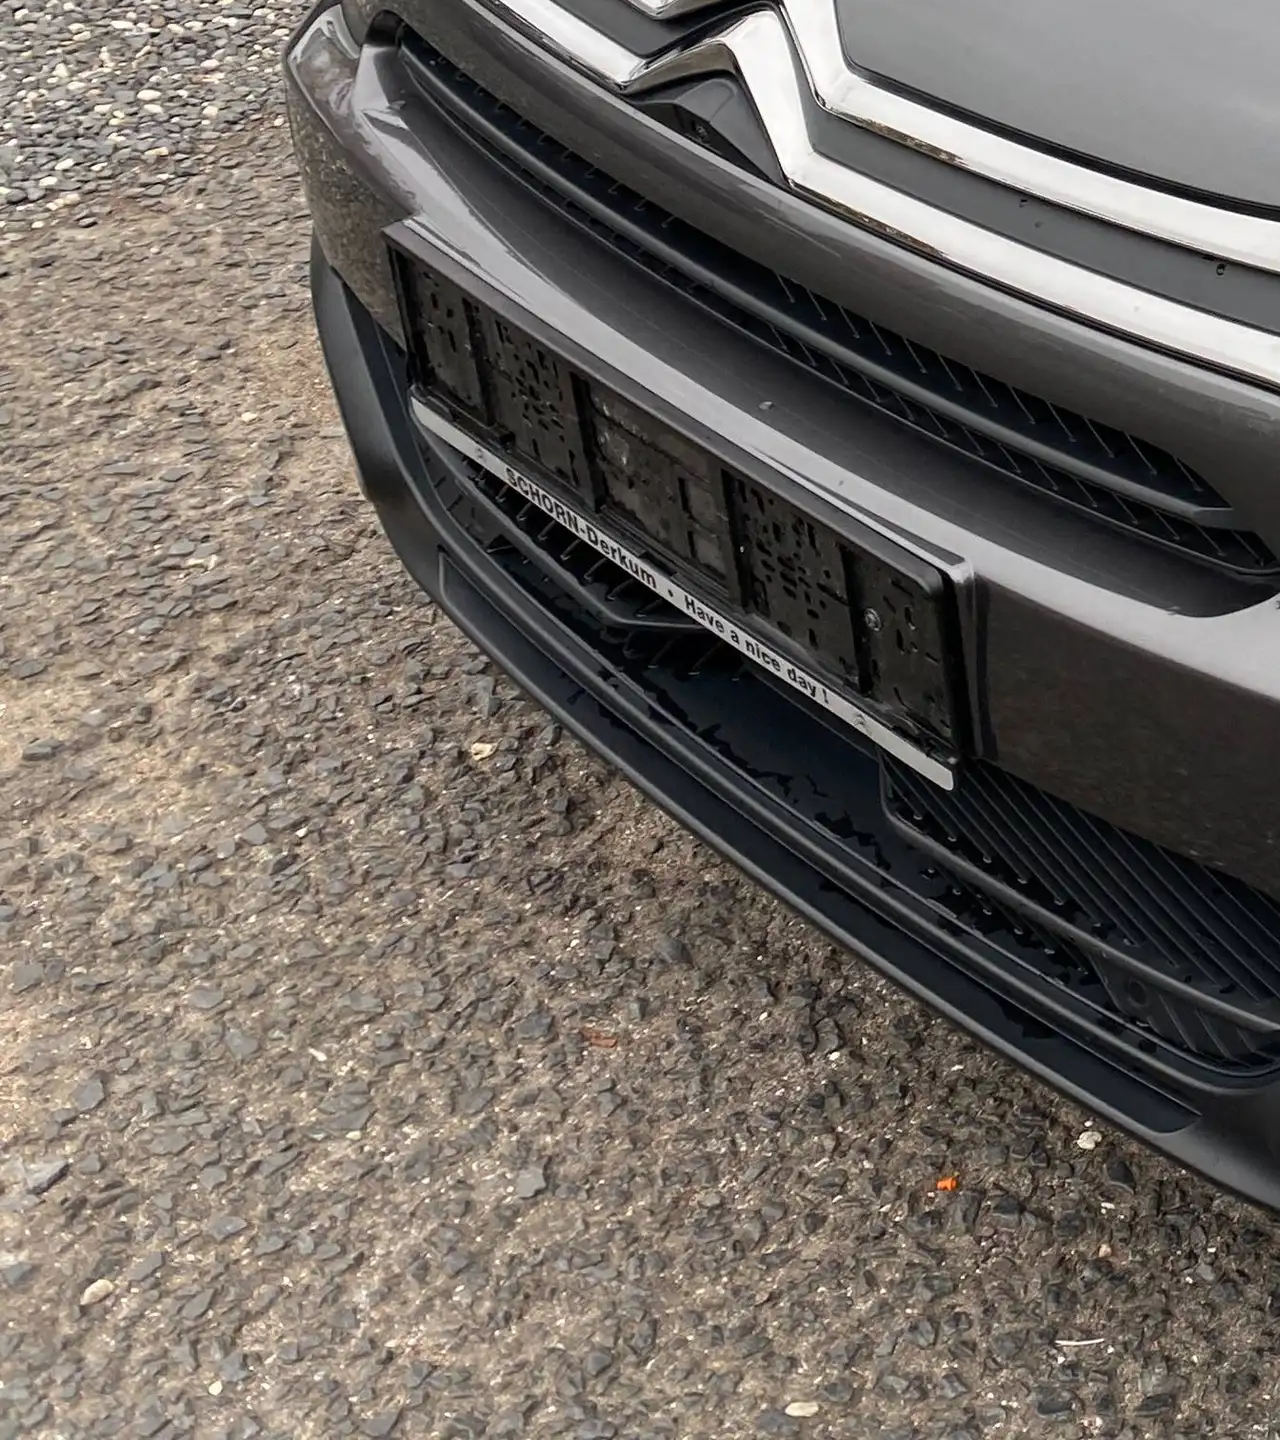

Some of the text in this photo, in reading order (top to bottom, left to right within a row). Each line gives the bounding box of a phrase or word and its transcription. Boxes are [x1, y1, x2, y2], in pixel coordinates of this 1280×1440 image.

[505, 467, 657, 588] SCHORN-Derkum
[684, 594, 725, 634] Have
[730, 630, 741, 645] a
[745, 638, 781, 673] nice
[787, 668, 817, 697] day
